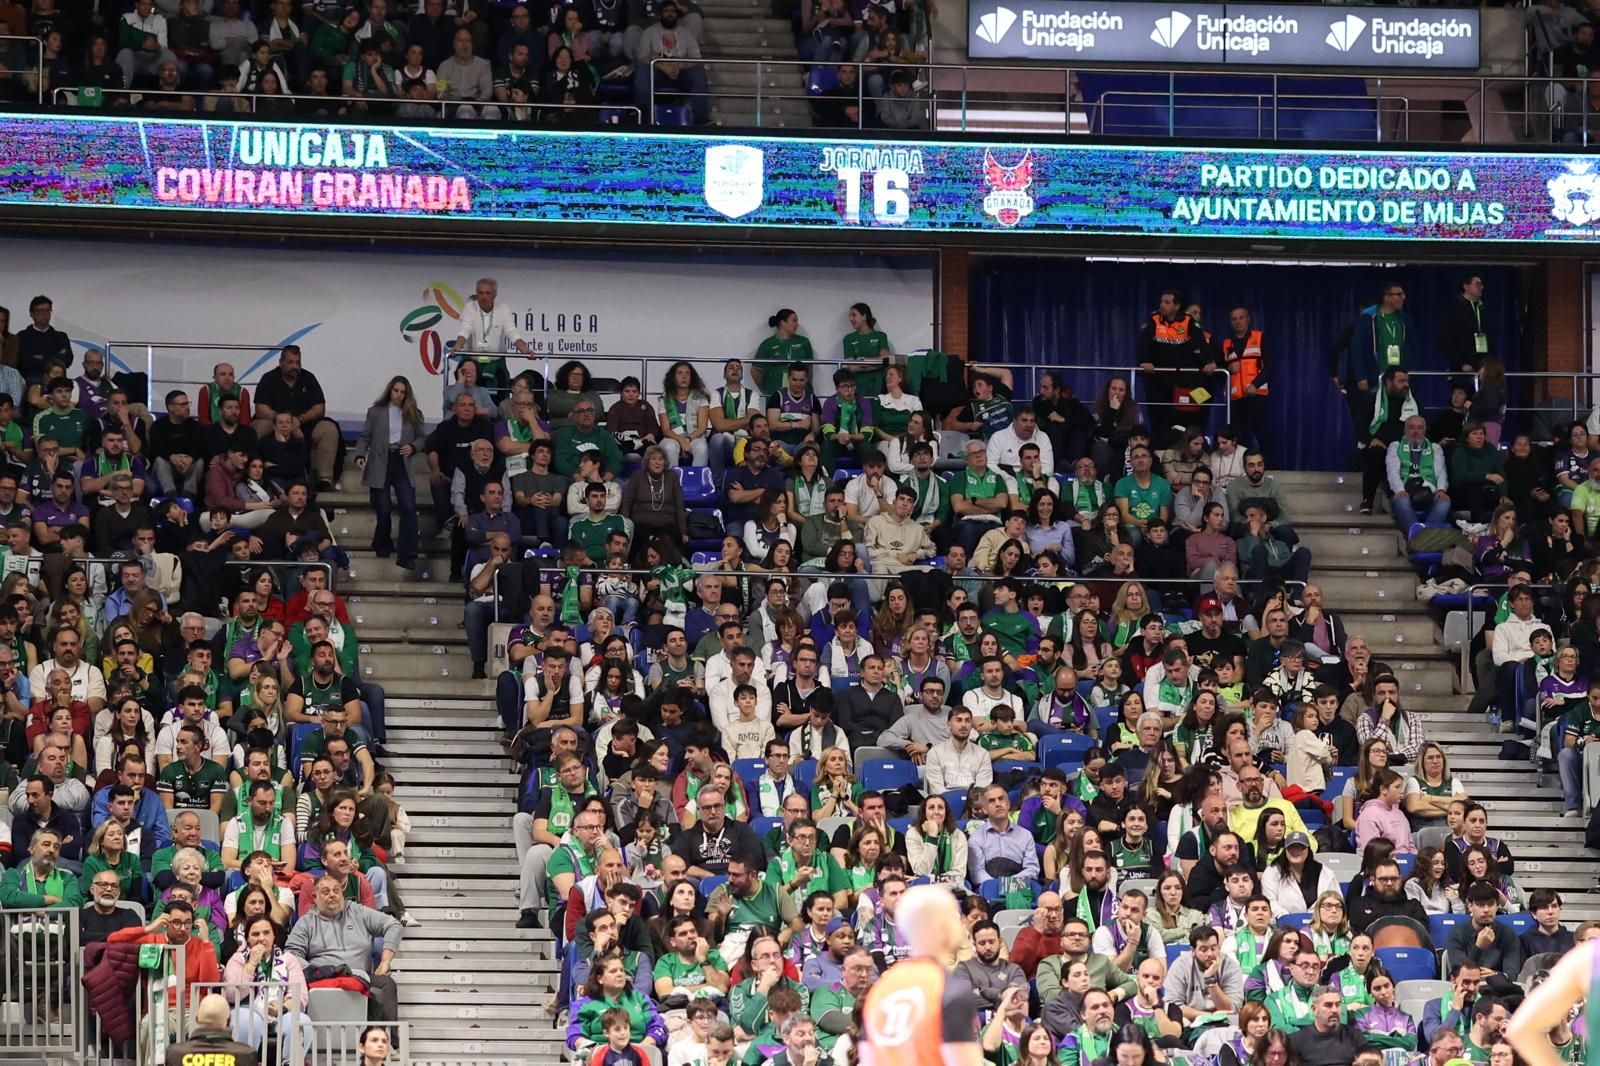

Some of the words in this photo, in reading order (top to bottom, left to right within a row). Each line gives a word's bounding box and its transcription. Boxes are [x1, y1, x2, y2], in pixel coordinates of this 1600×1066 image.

[1022, 11, 1123, 30] Fundación
[1197, 15, 1298, 34] Fundación
[1372, 18, 1472, 37] Fundación
[1022, 28, 1095, 51] Unicaja
[1197, 33, 1270, 55] Unicaja
[1372, 36, 1444, 57] Unicaja
[239, 130, 389, 168] UNICAJA
[819, 146, 924, 174] JORNADA
[1201, 164, 1312, 188] PARTIDO
[1320, 167, 1451, 191] DEDICADO
[1457, 169, 1476, 191] A
[156, 167, 304, 204] COVIRAN
[312, 174, 471, 211] GRANADA
[837, 168, 910, 225] 16
[1383, 201, 1416, 224] DE
[1423, 202, 1505, 225] MIJAS
[558, 338, 598, 352] Eventos
[182, 1053, 236, 1066] COFER
